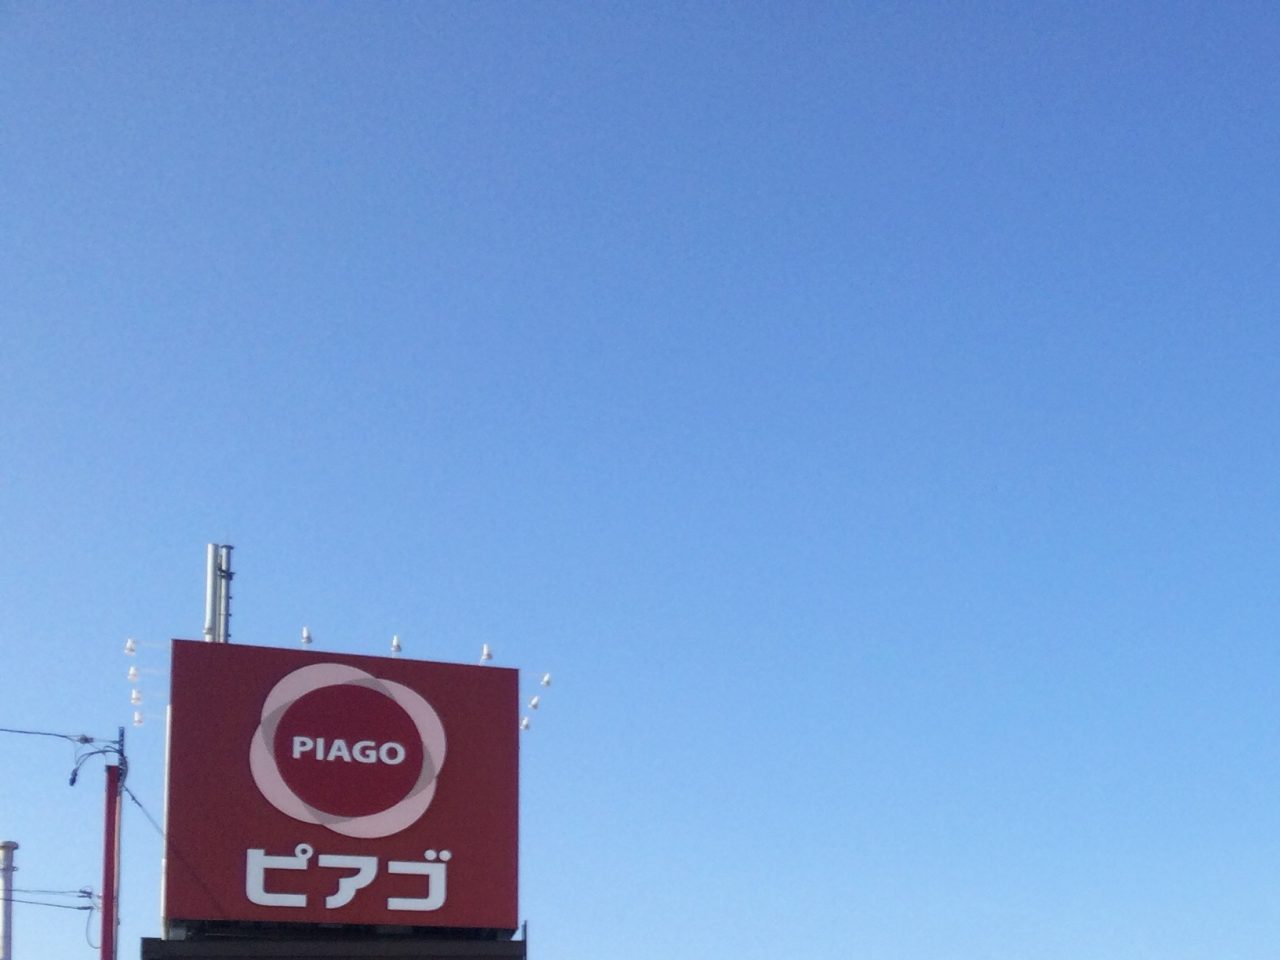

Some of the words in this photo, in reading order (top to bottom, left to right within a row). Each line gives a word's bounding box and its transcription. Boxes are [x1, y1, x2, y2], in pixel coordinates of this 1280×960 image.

[292, 736, 406, 765] PIAGO
[246, 843, 452, 912] ピアゴ
